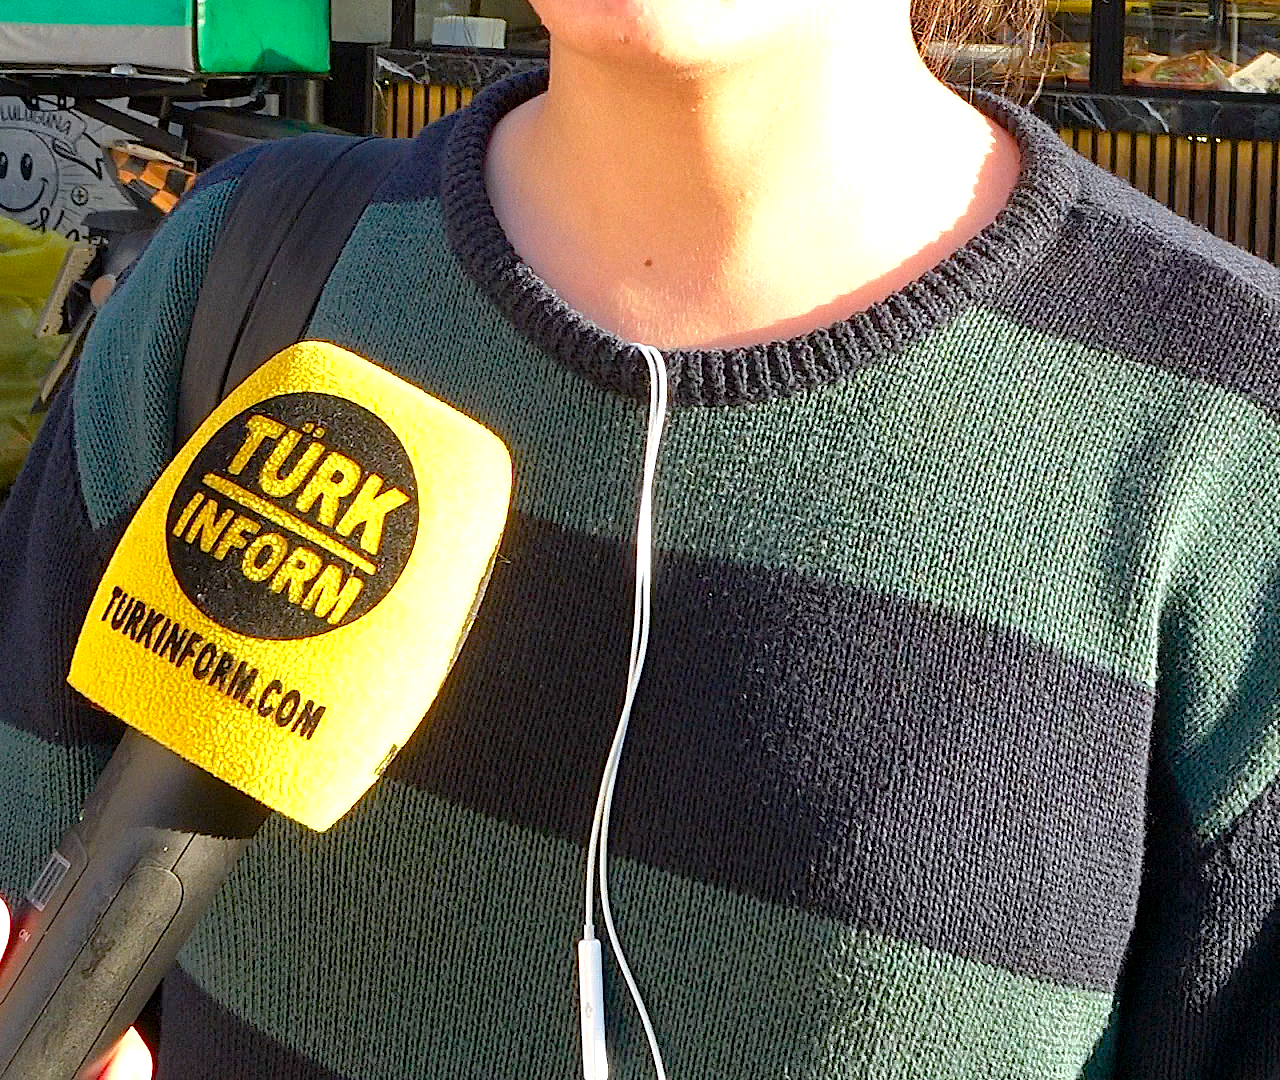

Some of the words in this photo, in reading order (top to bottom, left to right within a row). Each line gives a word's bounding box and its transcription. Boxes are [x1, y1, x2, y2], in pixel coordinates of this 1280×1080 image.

[226, 414, 410, 556] TÜRK
[172, 491, 364, 624] INFORM
[101, 586, 326, 741] TURKINFORM.COM
